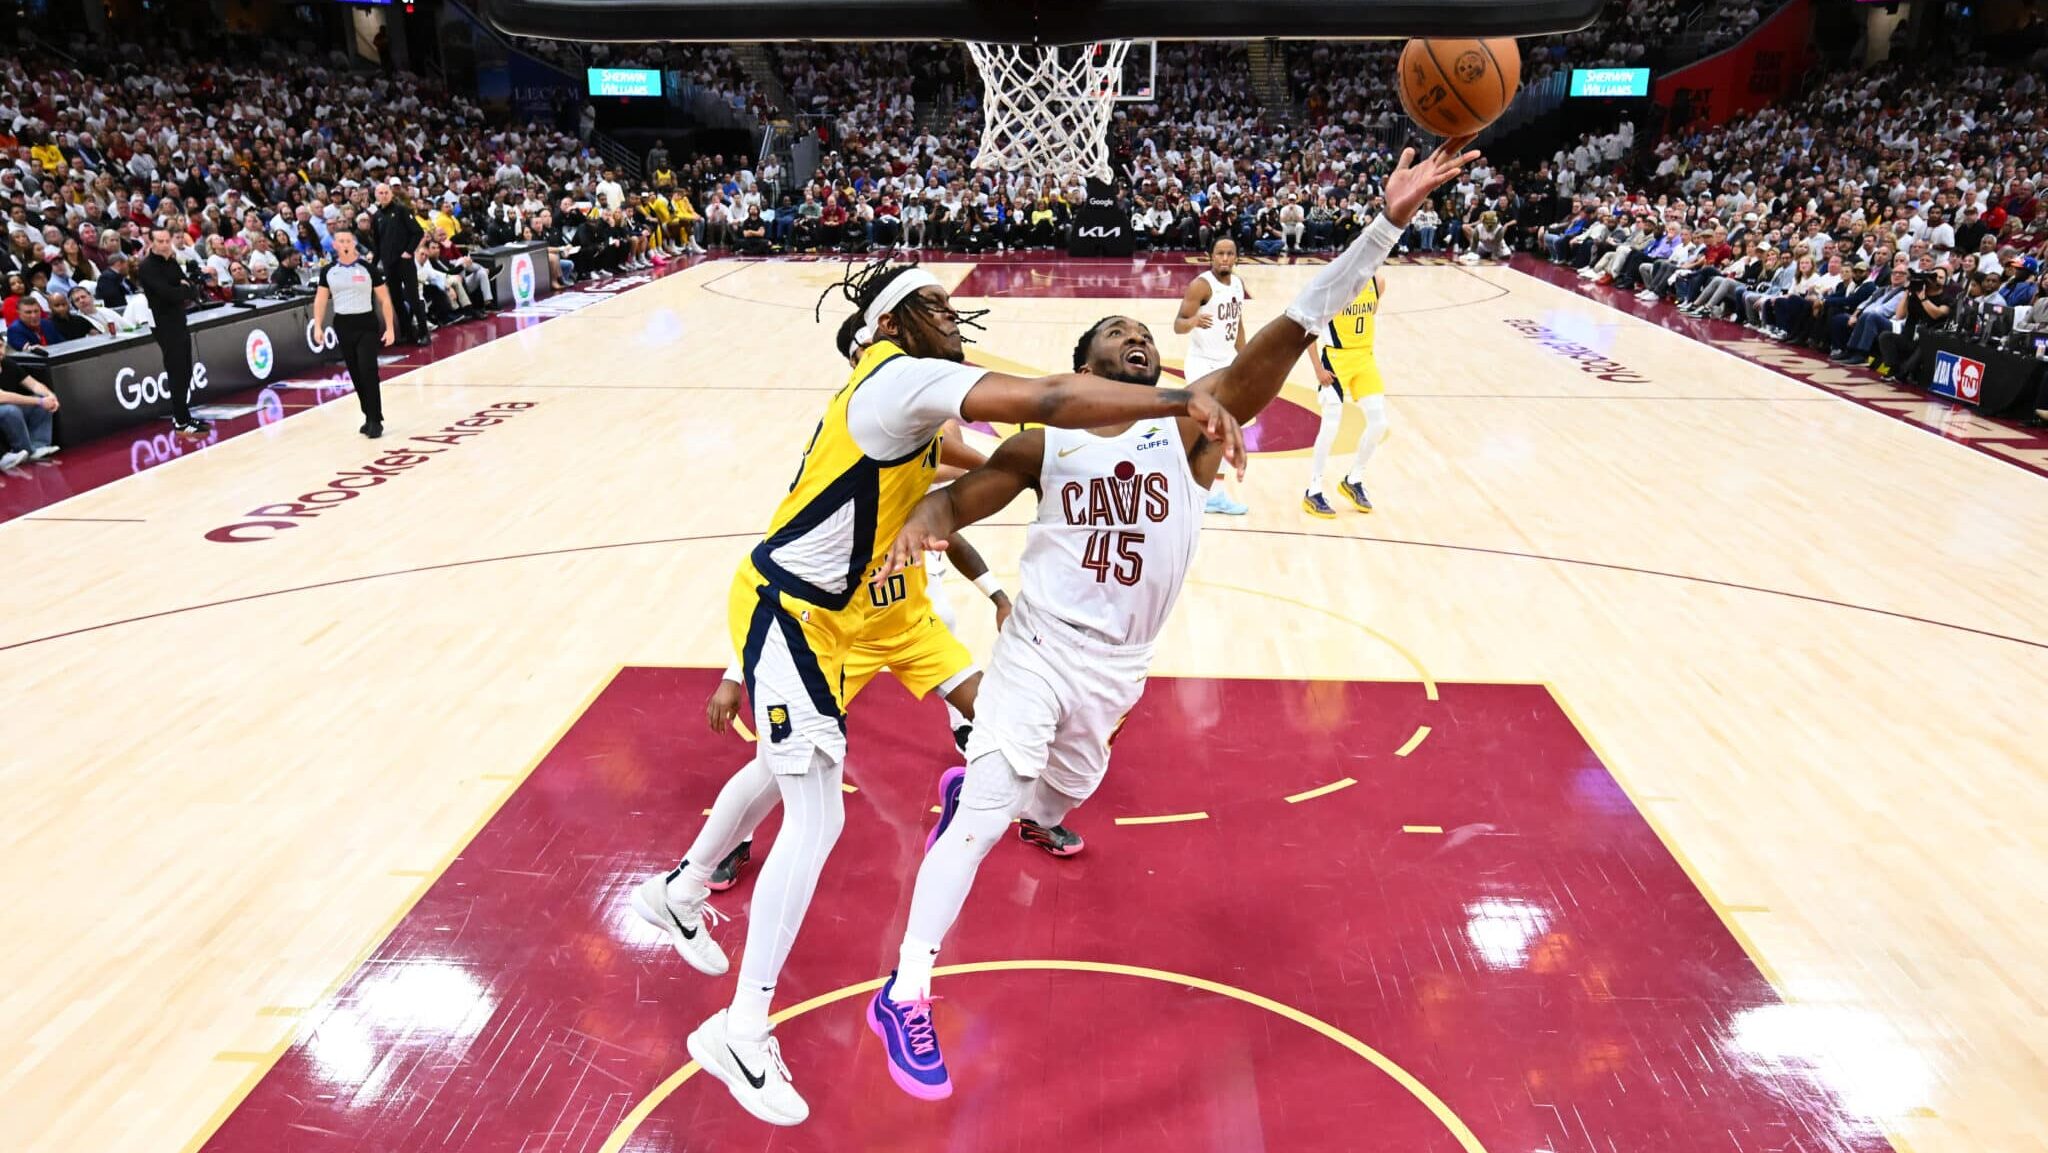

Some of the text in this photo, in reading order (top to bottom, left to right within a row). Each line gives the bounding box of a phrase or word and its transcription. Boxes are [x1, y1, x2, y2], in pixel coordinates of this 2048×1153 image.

[602, 71, 647, 83] SHERWIN
[1585, 71, 1632, 83] SHERWIN
[601, 83, 648, 95] WILLIAMS
[1583, 83, 1632, 95] WILLIAMS
[1089, 197, 1114, 207] Google
[1078, 226, 1121, 238] KIA
[1225, 321, 1238, 342] 35
[1355, 317, 1365, 334] 0
[1932, 359, 1980, 391] NBA TNT
[1136, 438, 1169, 451] CLIFFS
[243, 446, 449, 518] Rocket
[408, 401, 540, 446] Arena
[1061, 472, 1170, 527] CAVS
[1081, 530, 1146, 587] 45
[868, 573, 906, 608] 00
